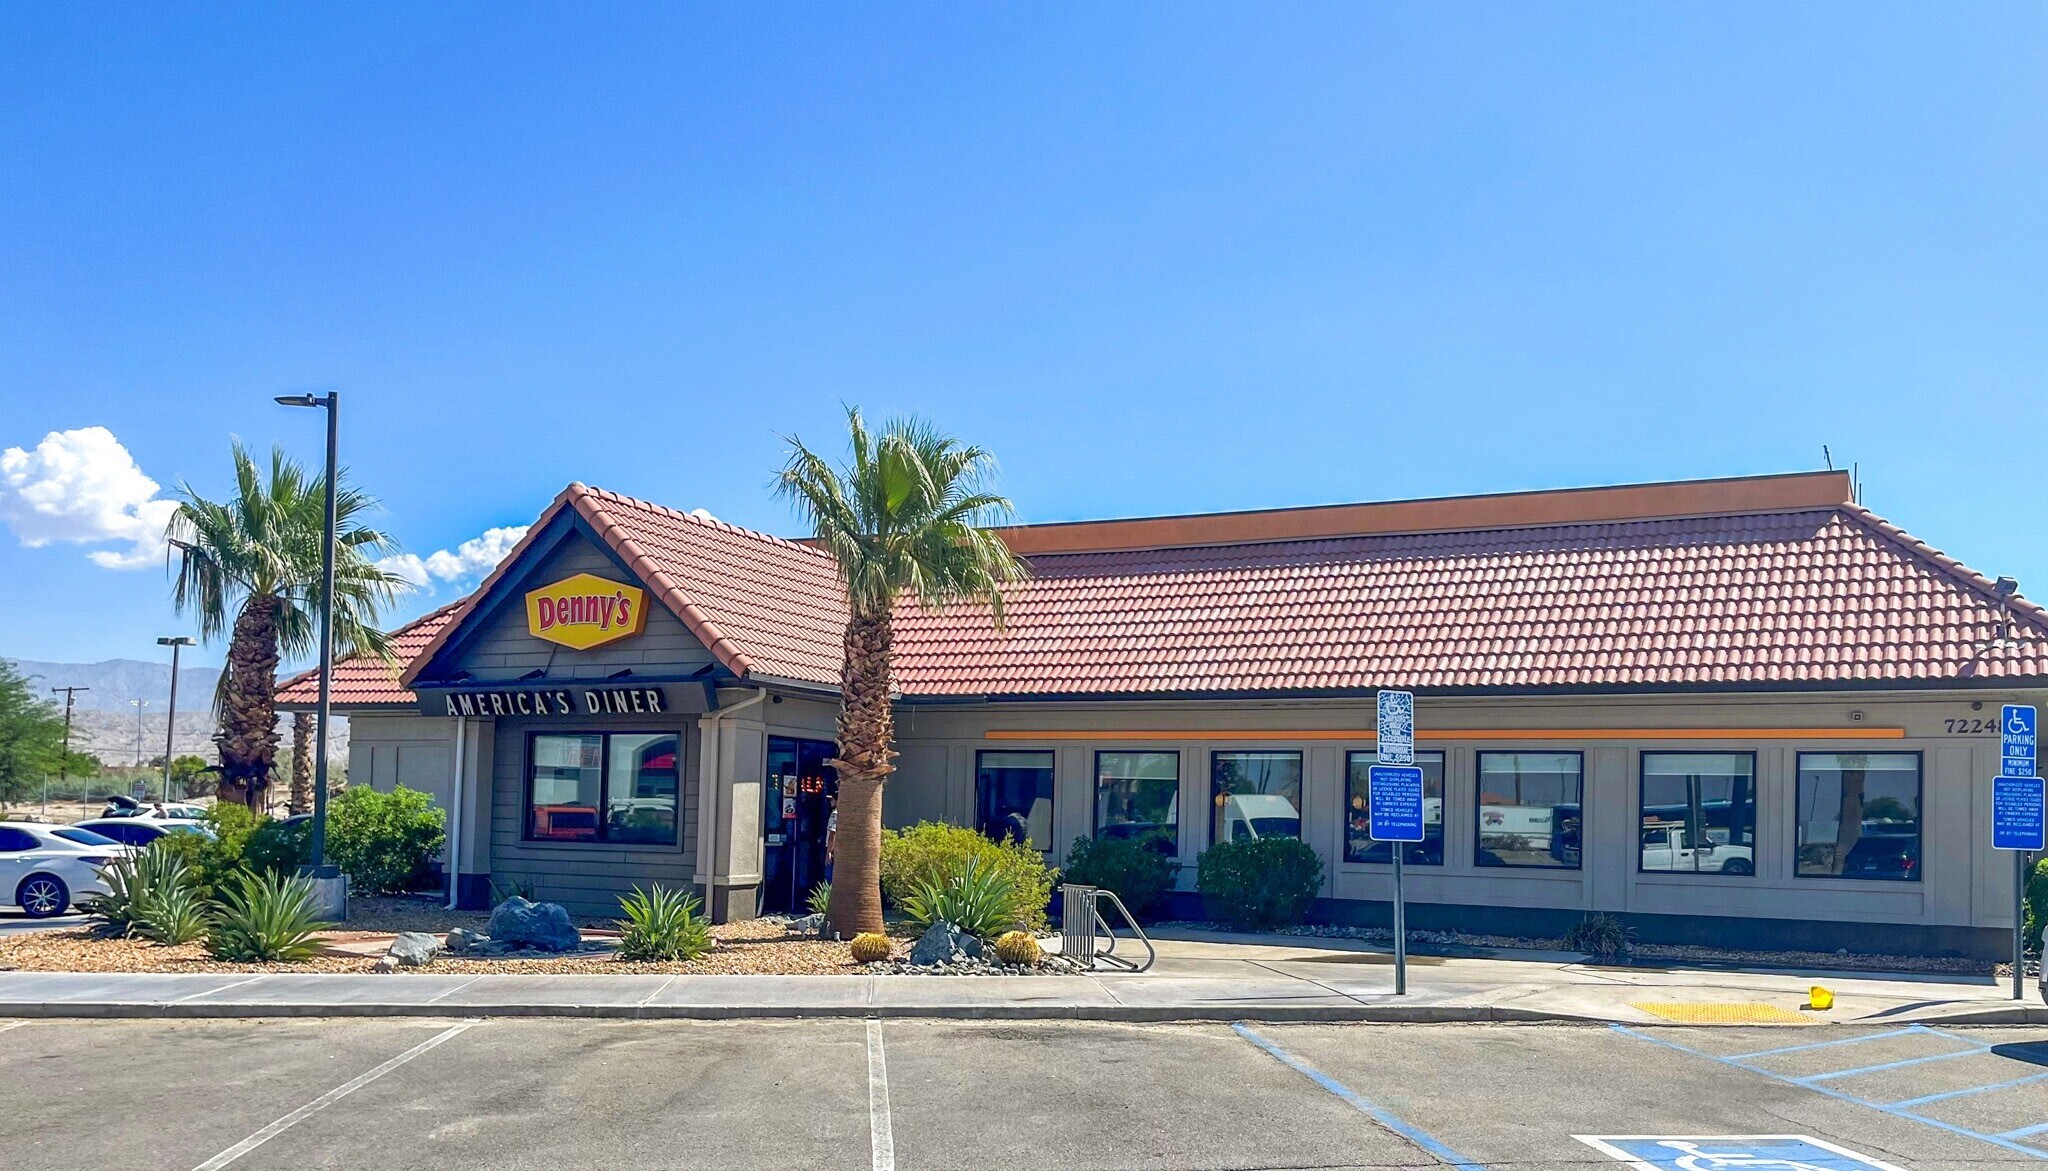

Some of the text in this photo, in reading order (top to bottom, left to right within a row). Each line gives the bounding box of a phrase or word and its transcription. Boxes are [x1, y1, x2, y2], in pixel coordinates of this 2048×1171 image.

[537, 591, 631, 631] Denny's
[446, 690, 662, 716] AMERICA'S DINER
[1944, 718, 2001, 733] 7224
[2004, 734, 2034, 745] PARKING
[2010, 746, 2027, 756] ONLY
